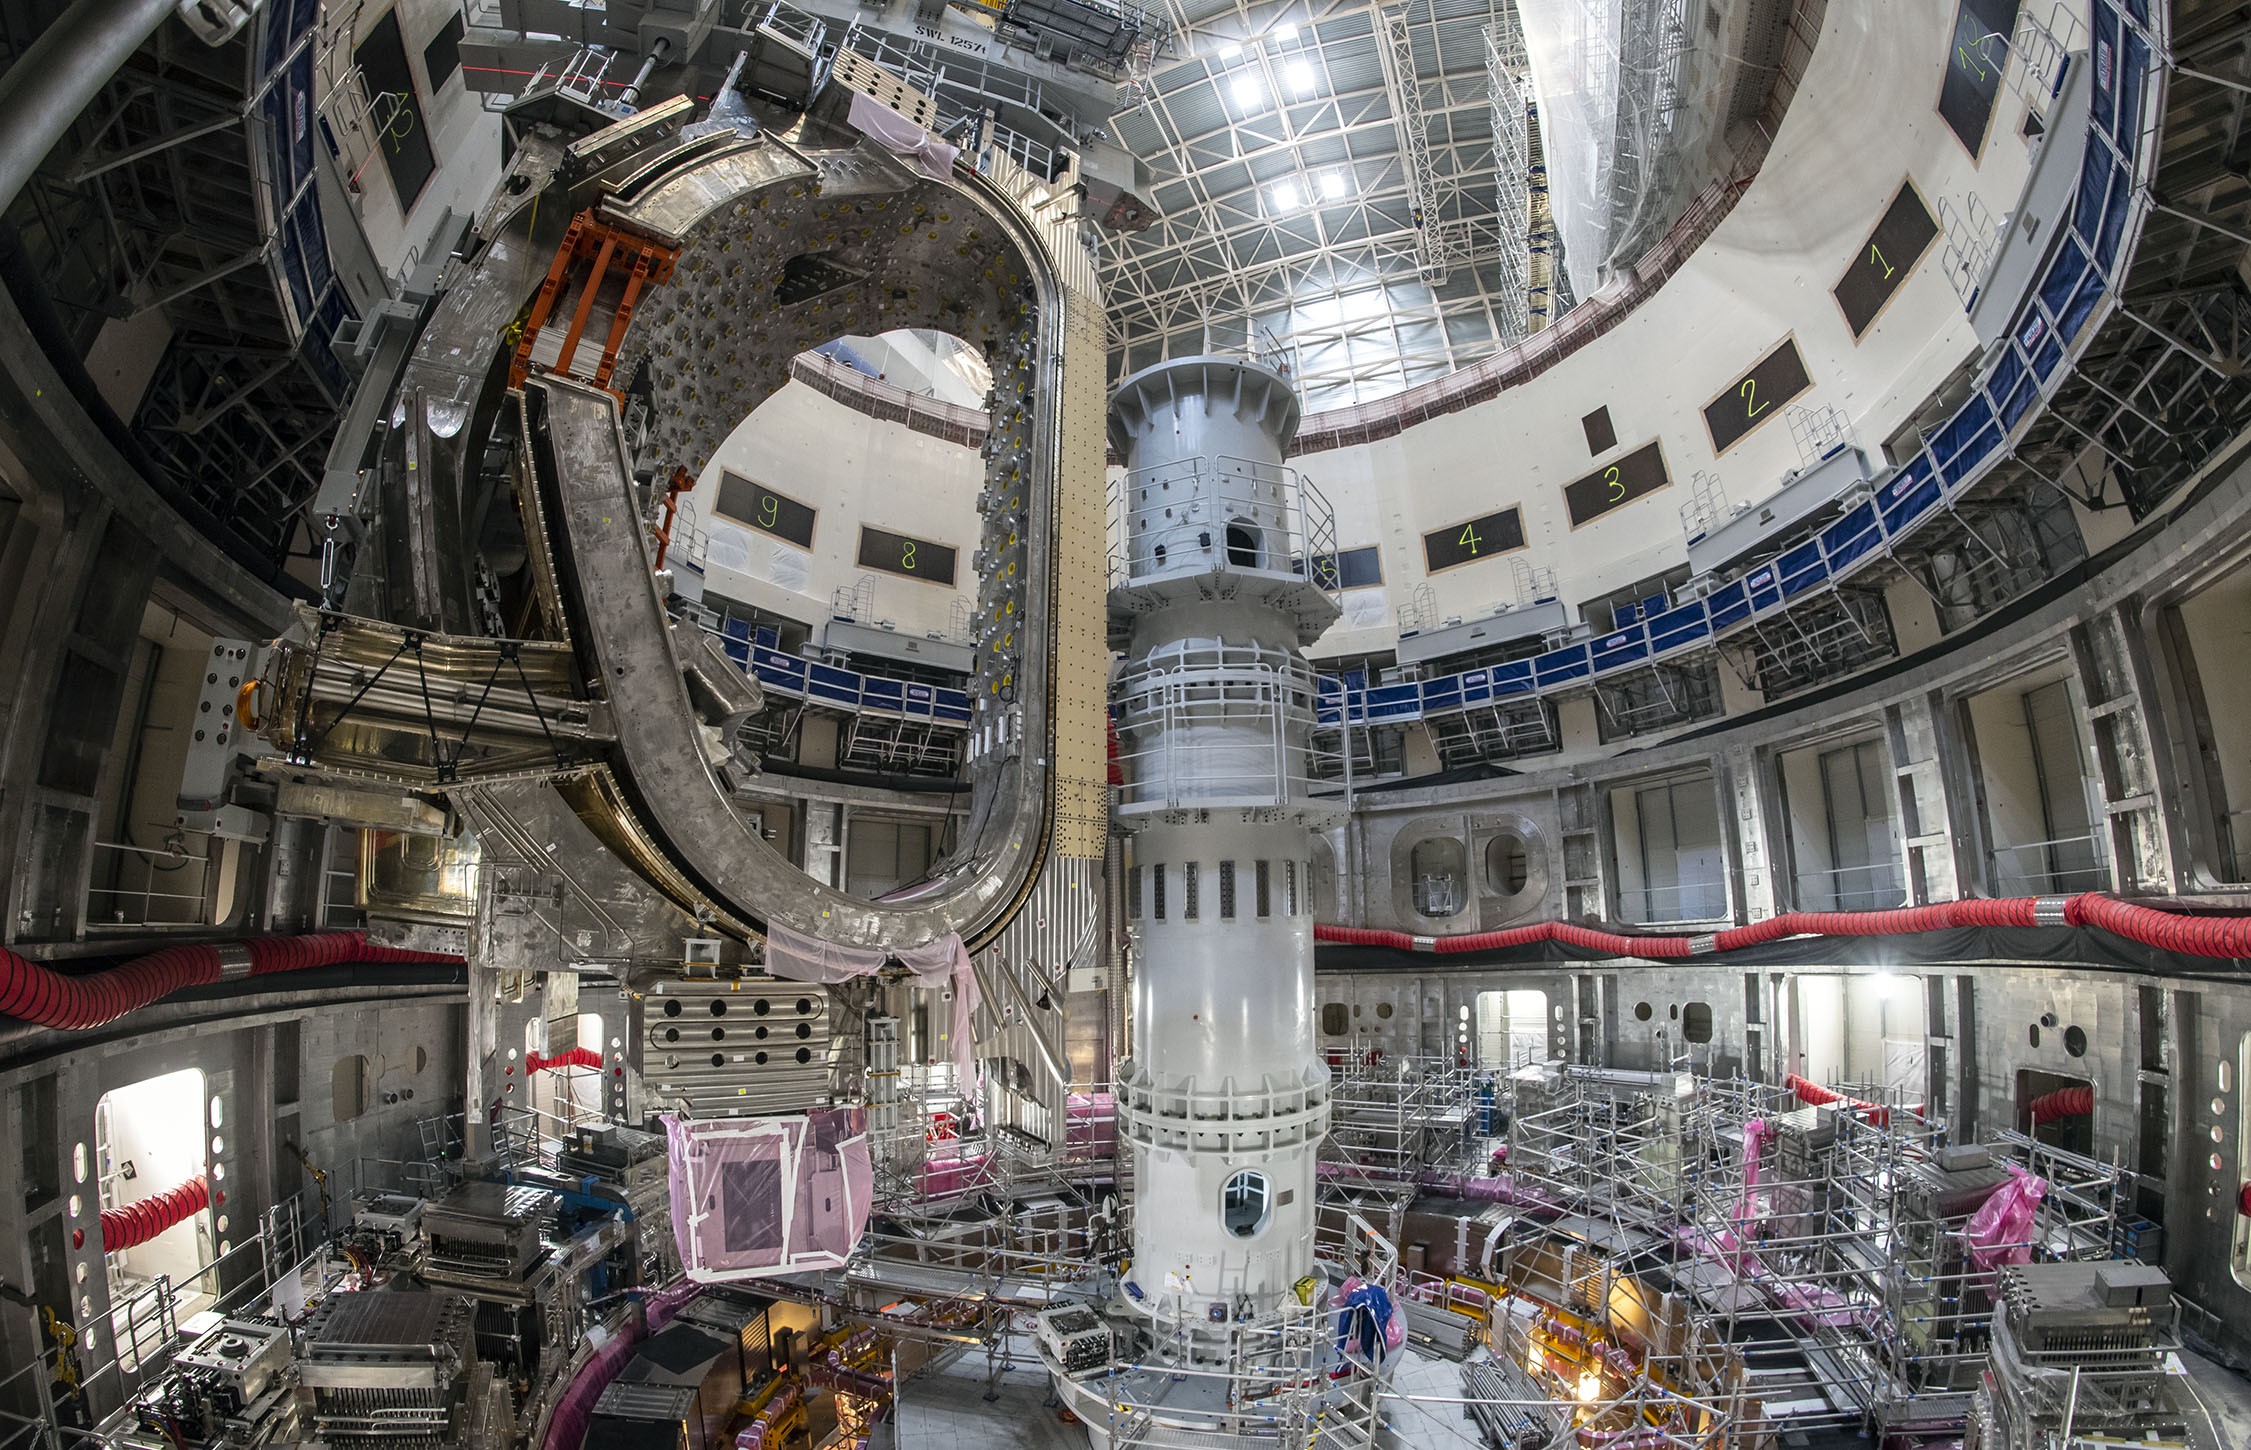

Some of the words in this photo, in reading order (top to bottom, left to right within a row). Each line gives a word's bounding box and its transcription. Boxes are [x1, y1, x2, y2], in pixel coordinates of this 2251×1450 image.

[915, 25, 945, 42] SWL
[950, 36, 987, 55] 1257t
[1871, 243, 1895, 280] 1
[1740, 379, 1770, 418] 2
[1604, 466, 1626, 503] 3
[757, 495, 778, 528] 9
[1458, 523, 1482, 554] 4
[902, 541, 916, 570] 8
[1320, 559, 1338, 582] 5
